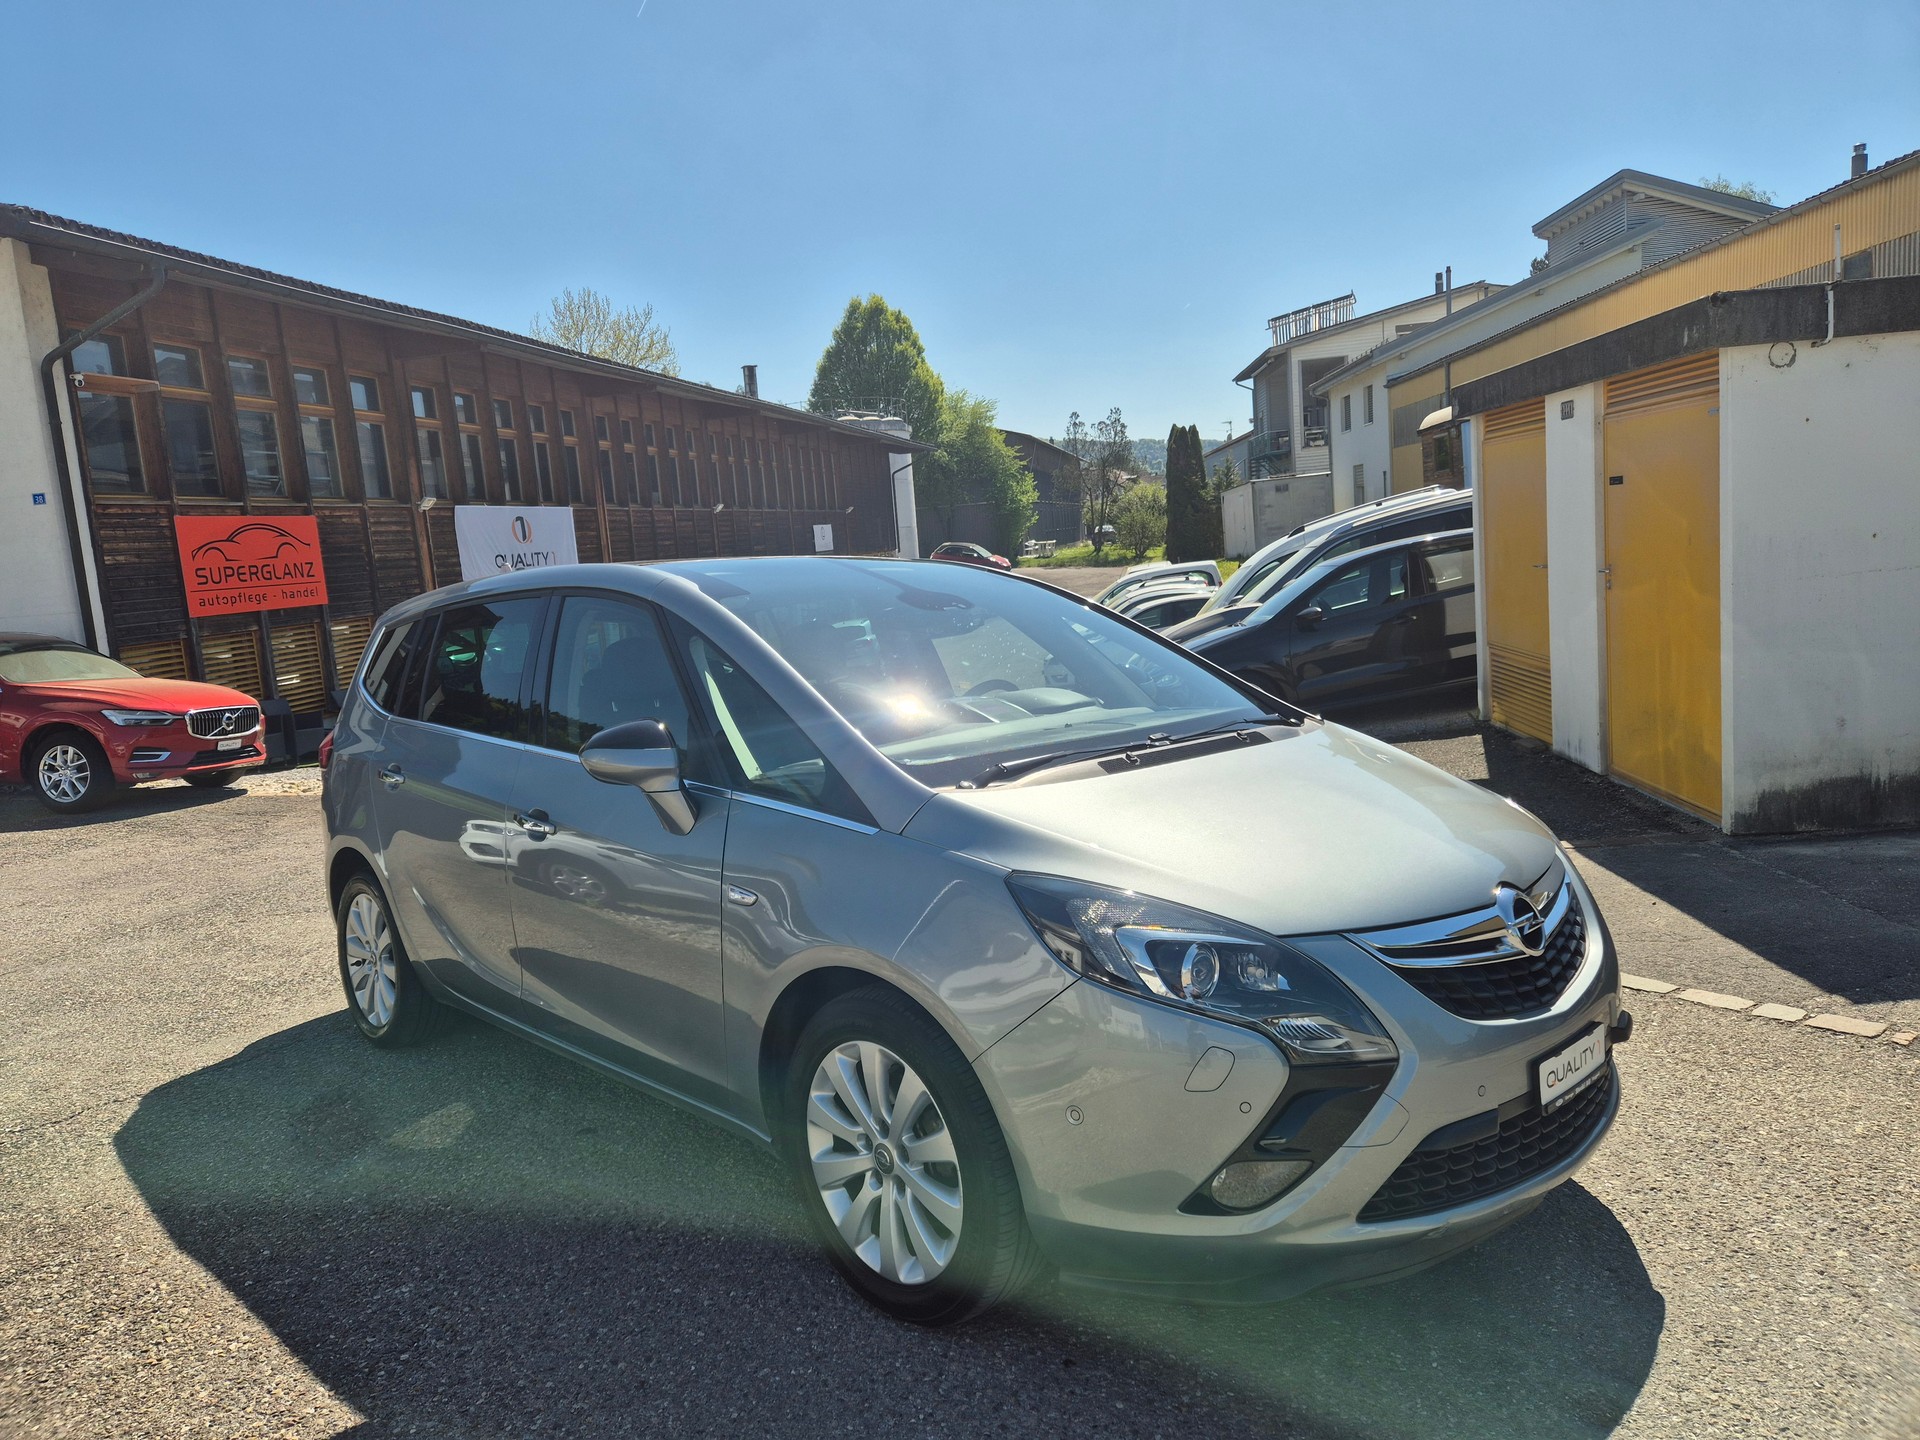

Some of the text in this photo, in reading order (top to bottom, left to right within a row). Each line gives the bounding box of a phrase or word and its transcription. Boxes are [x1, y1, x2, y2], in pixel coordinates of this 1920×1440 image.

[34, 495, 44, 503] 38
[195, 562, 315, 585] SUPERGLANZ
[199, 592, 268, 607] autopflege
[281, 586, 319, 599] handel
[1546, 1042, 1596, 1089] QUALITY
